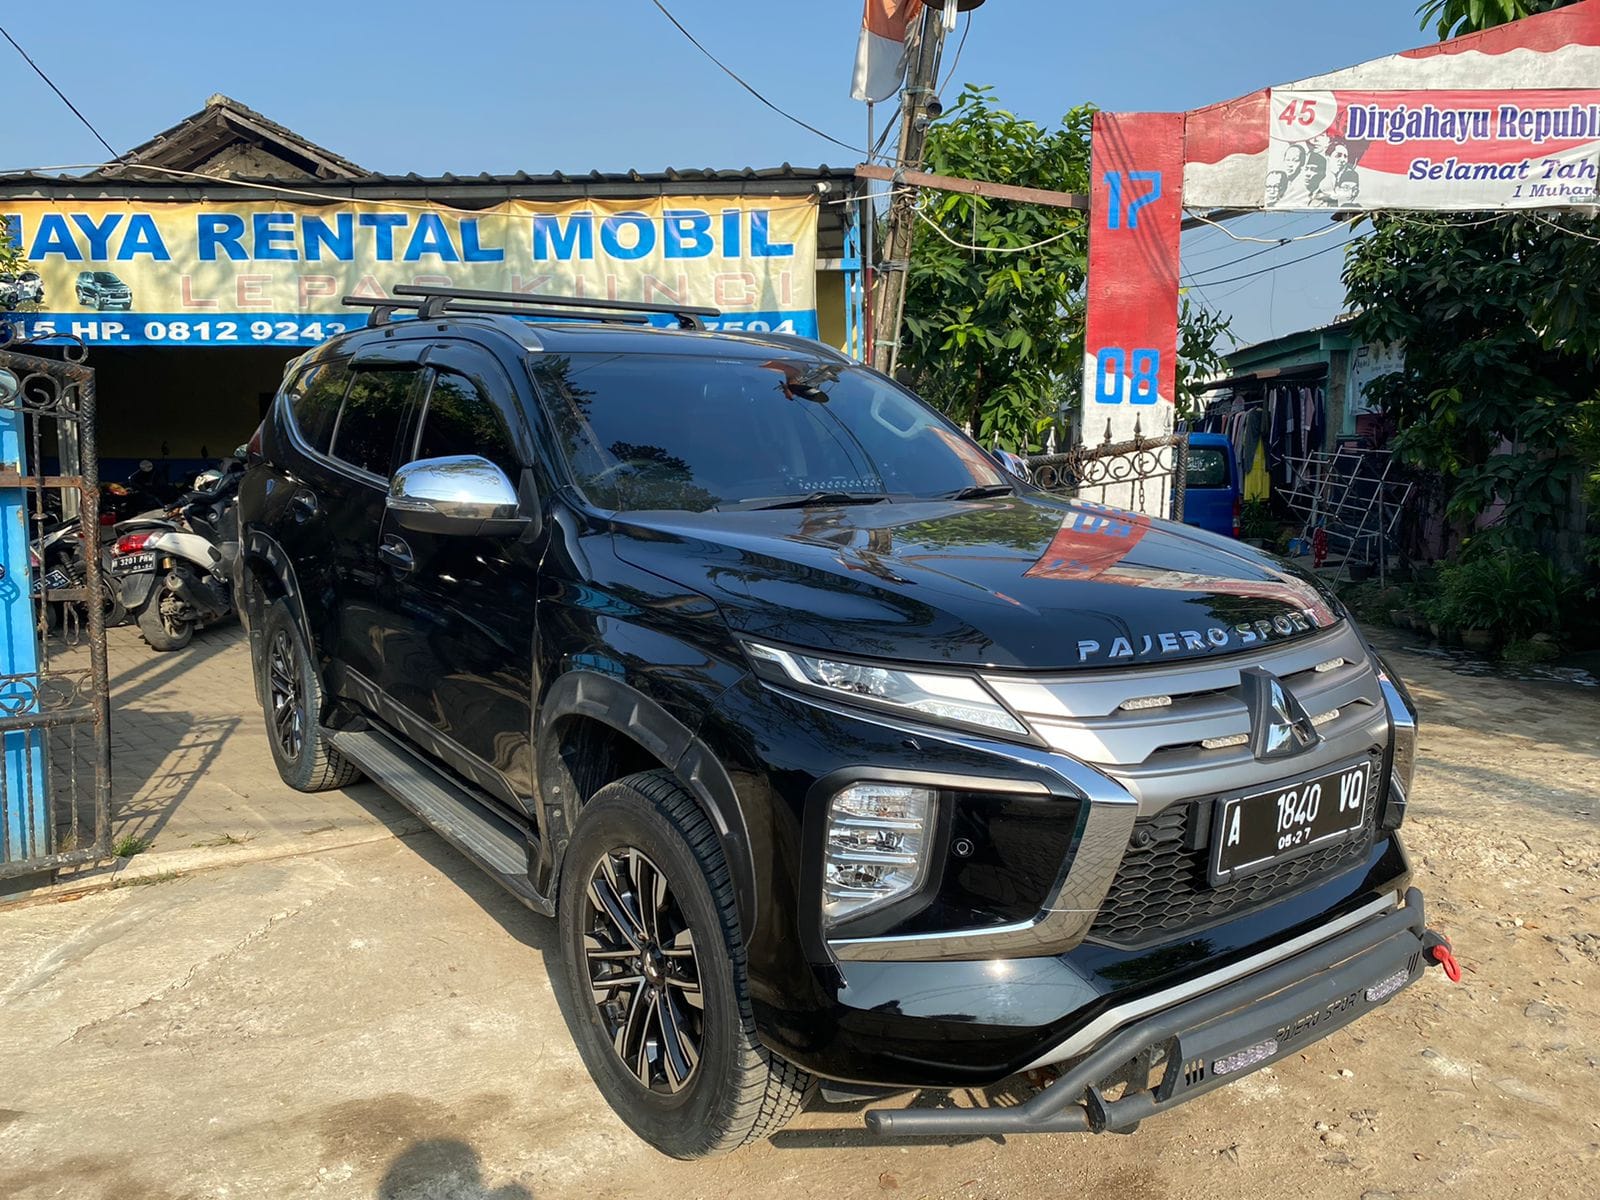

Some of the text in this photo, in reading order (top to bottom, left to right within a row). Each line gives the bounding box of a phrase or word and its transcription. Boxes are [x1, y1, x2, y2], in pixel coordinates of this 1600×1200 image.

[1279, 99, 1317, 126] 45
[1347, 105, 1600, 142] Dirgahayu Republ
[1408, 158, 1530, 181] Selamat
[1512, 186, 1522, 198] 1
[1103, 170, 1162, 230] 17
[197, 212, 504, 262] RENTAL
[532, 208, 795, 261] MOBIL
[72, 322, 130, 341] HP.
[145, 320, 238, 342] 0812
[1094, 346, 1161, 405] 08
[1077, 608, 1322, 663] PAJERO SPORT
[1227, 806, 1241, 848] A
[1276, 782, 1322, 834] 1840
